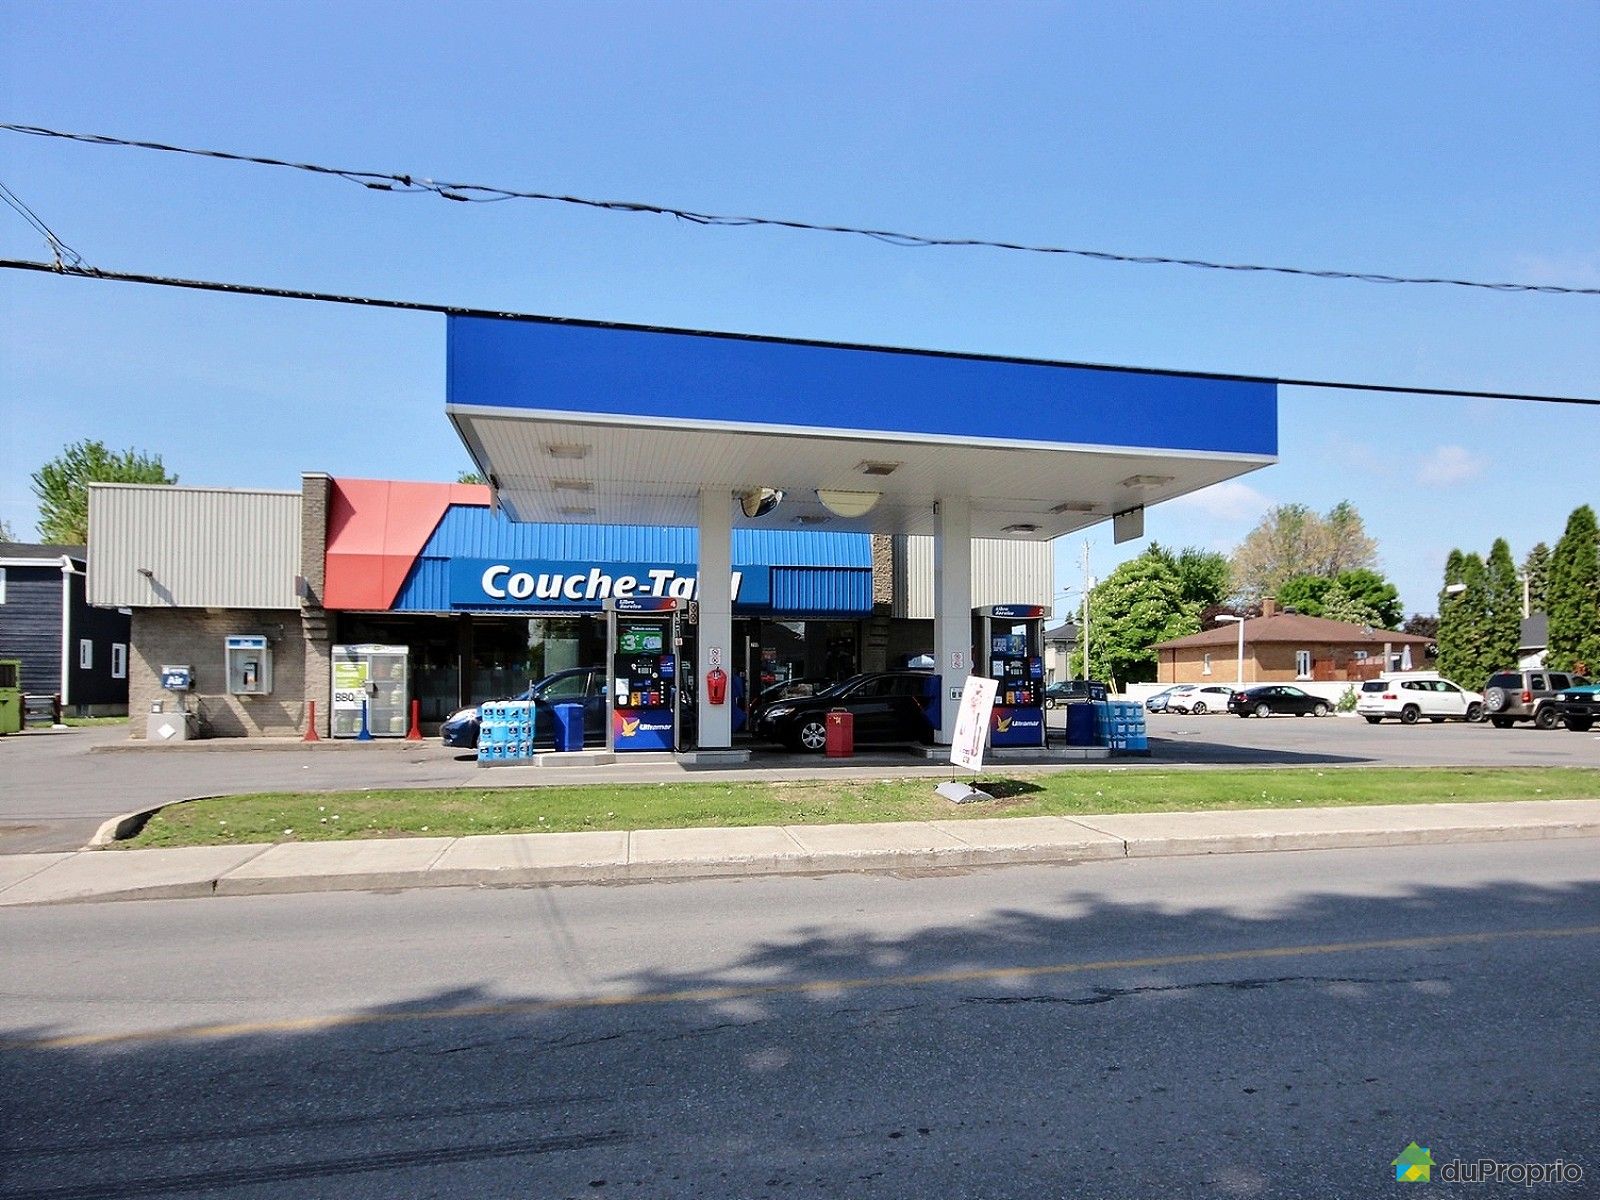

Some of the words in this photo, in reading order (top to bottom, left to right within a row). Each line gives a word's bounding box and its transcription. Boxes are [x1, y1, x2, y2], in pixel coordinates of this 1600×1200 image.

[481, 565, 742, 602] Couche-Ta
[669, 600, 676, 608] 4
[639, 723, 672, 731] Ultramar
